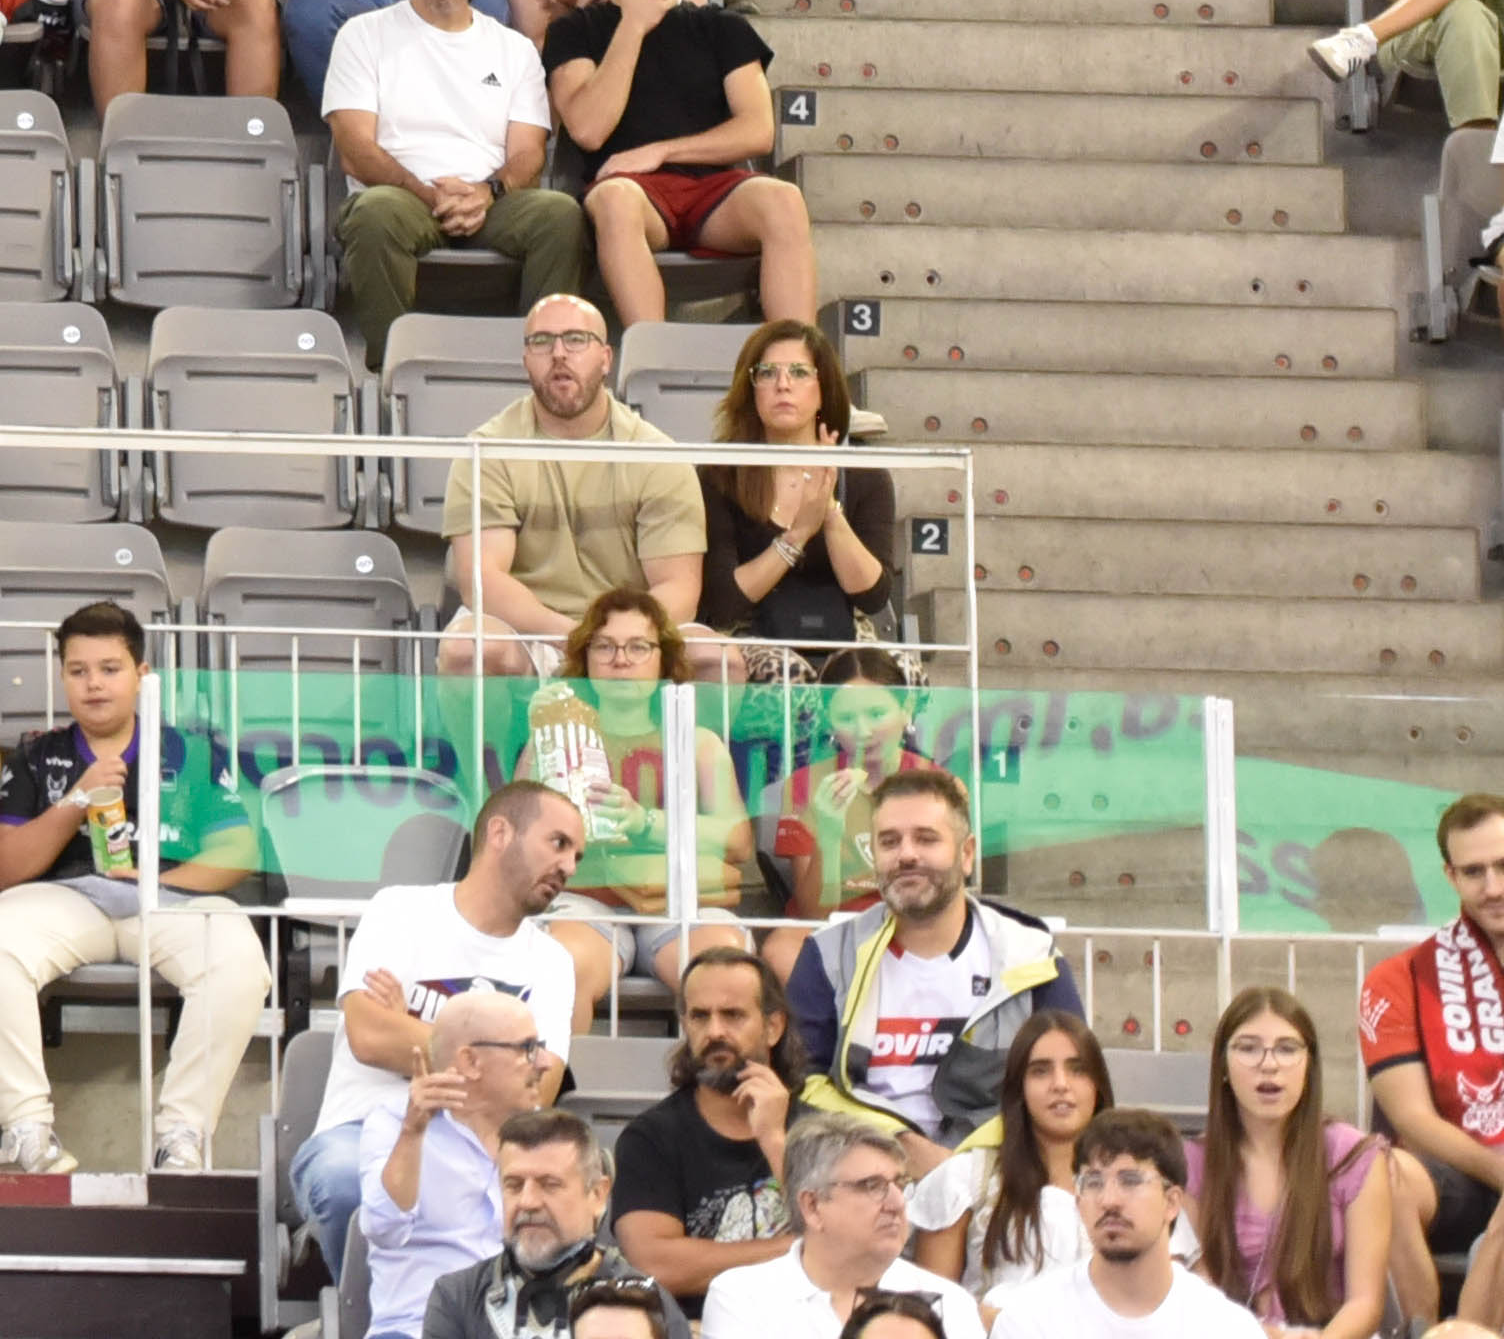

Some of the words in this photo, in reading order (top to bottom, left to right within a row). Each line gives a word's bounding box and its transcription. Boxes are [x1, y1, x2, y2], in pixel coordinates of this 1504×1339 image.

[788, 95, 810, 121] 4
[851, 303, 873, 331] 3
[921, 523, 942, 551] 2
[992, 750, 1007, 779] 1
